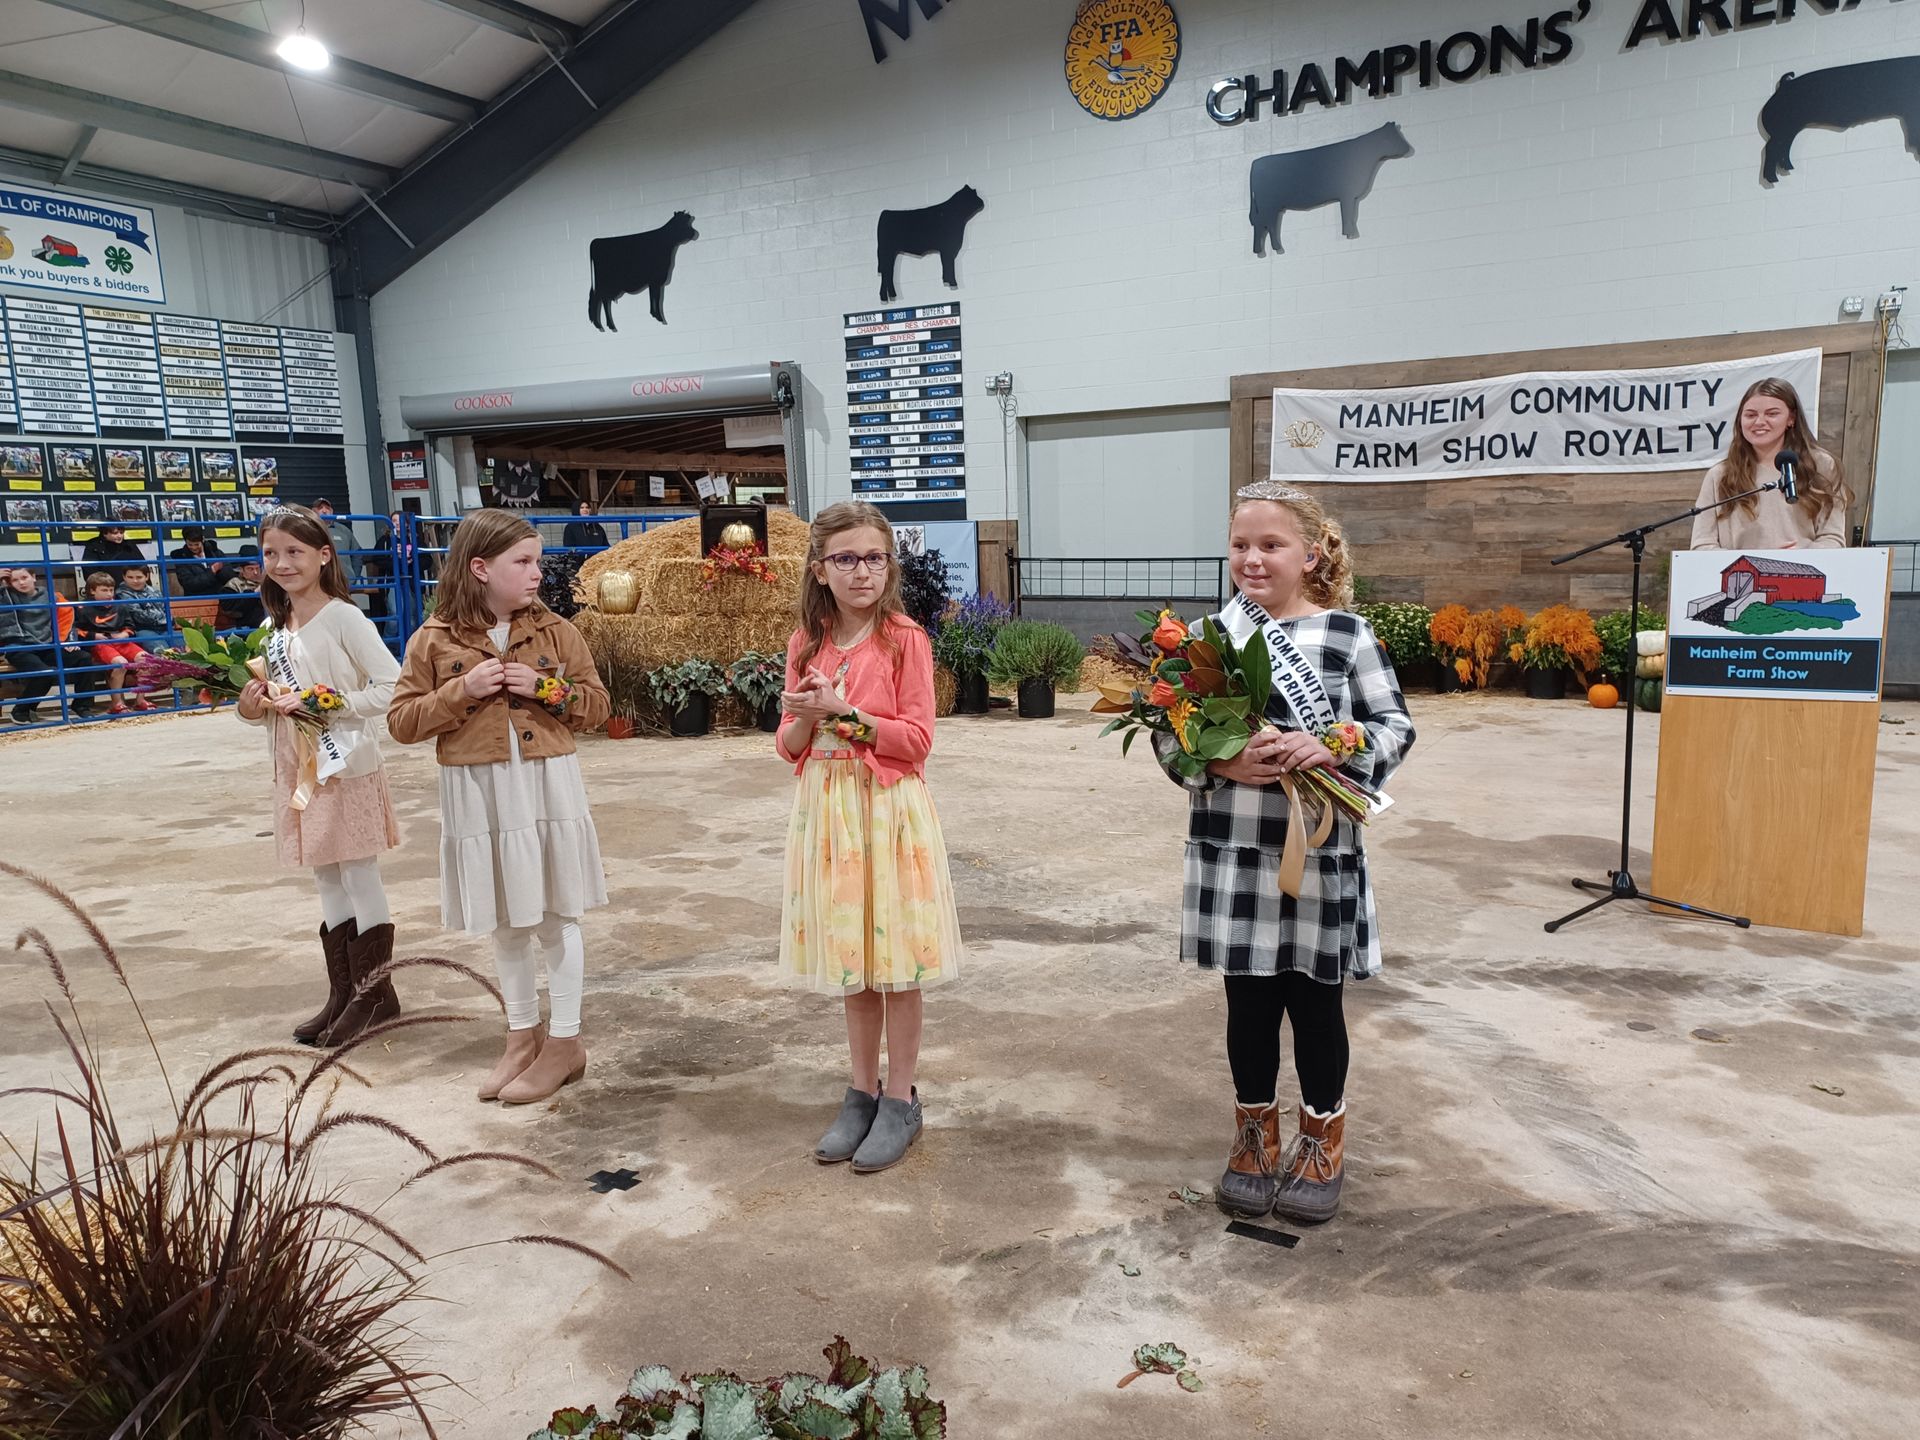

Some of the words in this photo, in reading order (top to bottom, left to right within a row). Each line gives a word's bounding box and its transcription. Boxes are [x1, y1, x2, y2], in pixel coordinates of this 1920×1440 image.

[1082, 3, 1159, 49] AGRICULTURAL
[1100, 18, 1143, 43] FFA
[1207, 1, 1591, 123] CHAMPIONS'
[1088, 67, 1154, 99] EDUCATION
[21, 199, 42, 212] OF
[45, 203, 133, 231] CHAMPIONS
[19, 268, 44, 280] you
[47, 270, 90, 287] buyers
[94, 276, 102, 287] &
[105, 278, 150, 294] bidders
[856, 314, 876, 323] THANKS
[922, 306, 944, 316] BUYERS
[857, 324, 890, 334] CHAMPION
[922, 318, 957, 327] CHAMPION
[890, 333, 915, 342] BUYERS
[47, 380, 82, 388] CONSTRUCTION
[632, 376, 704, 396] COOKSON
[454, 392, 514, 411] COOKSON
[1340, 394, 1485, 429] MANHEIM
[1510, 378, 1723, 415] COMMUNITY
[1335, 442, 1418, 468] FARM
[1443, 431, 1538, 460] SHOW
[1564, 421, 1728, 457] ROYALTY
[1235, 590, 1270, 627] NHEIM
[1266, 629, 1328, 704] COMMUNITY
[1690, 646, 1757, 660] Manheim
[1762, 647, 1853, 665] Community
[276, 634, 302, 693] COMMUNITY
[1727, 665, 1765, 679] Farm
[1770, 667, 1809, 680] Show
